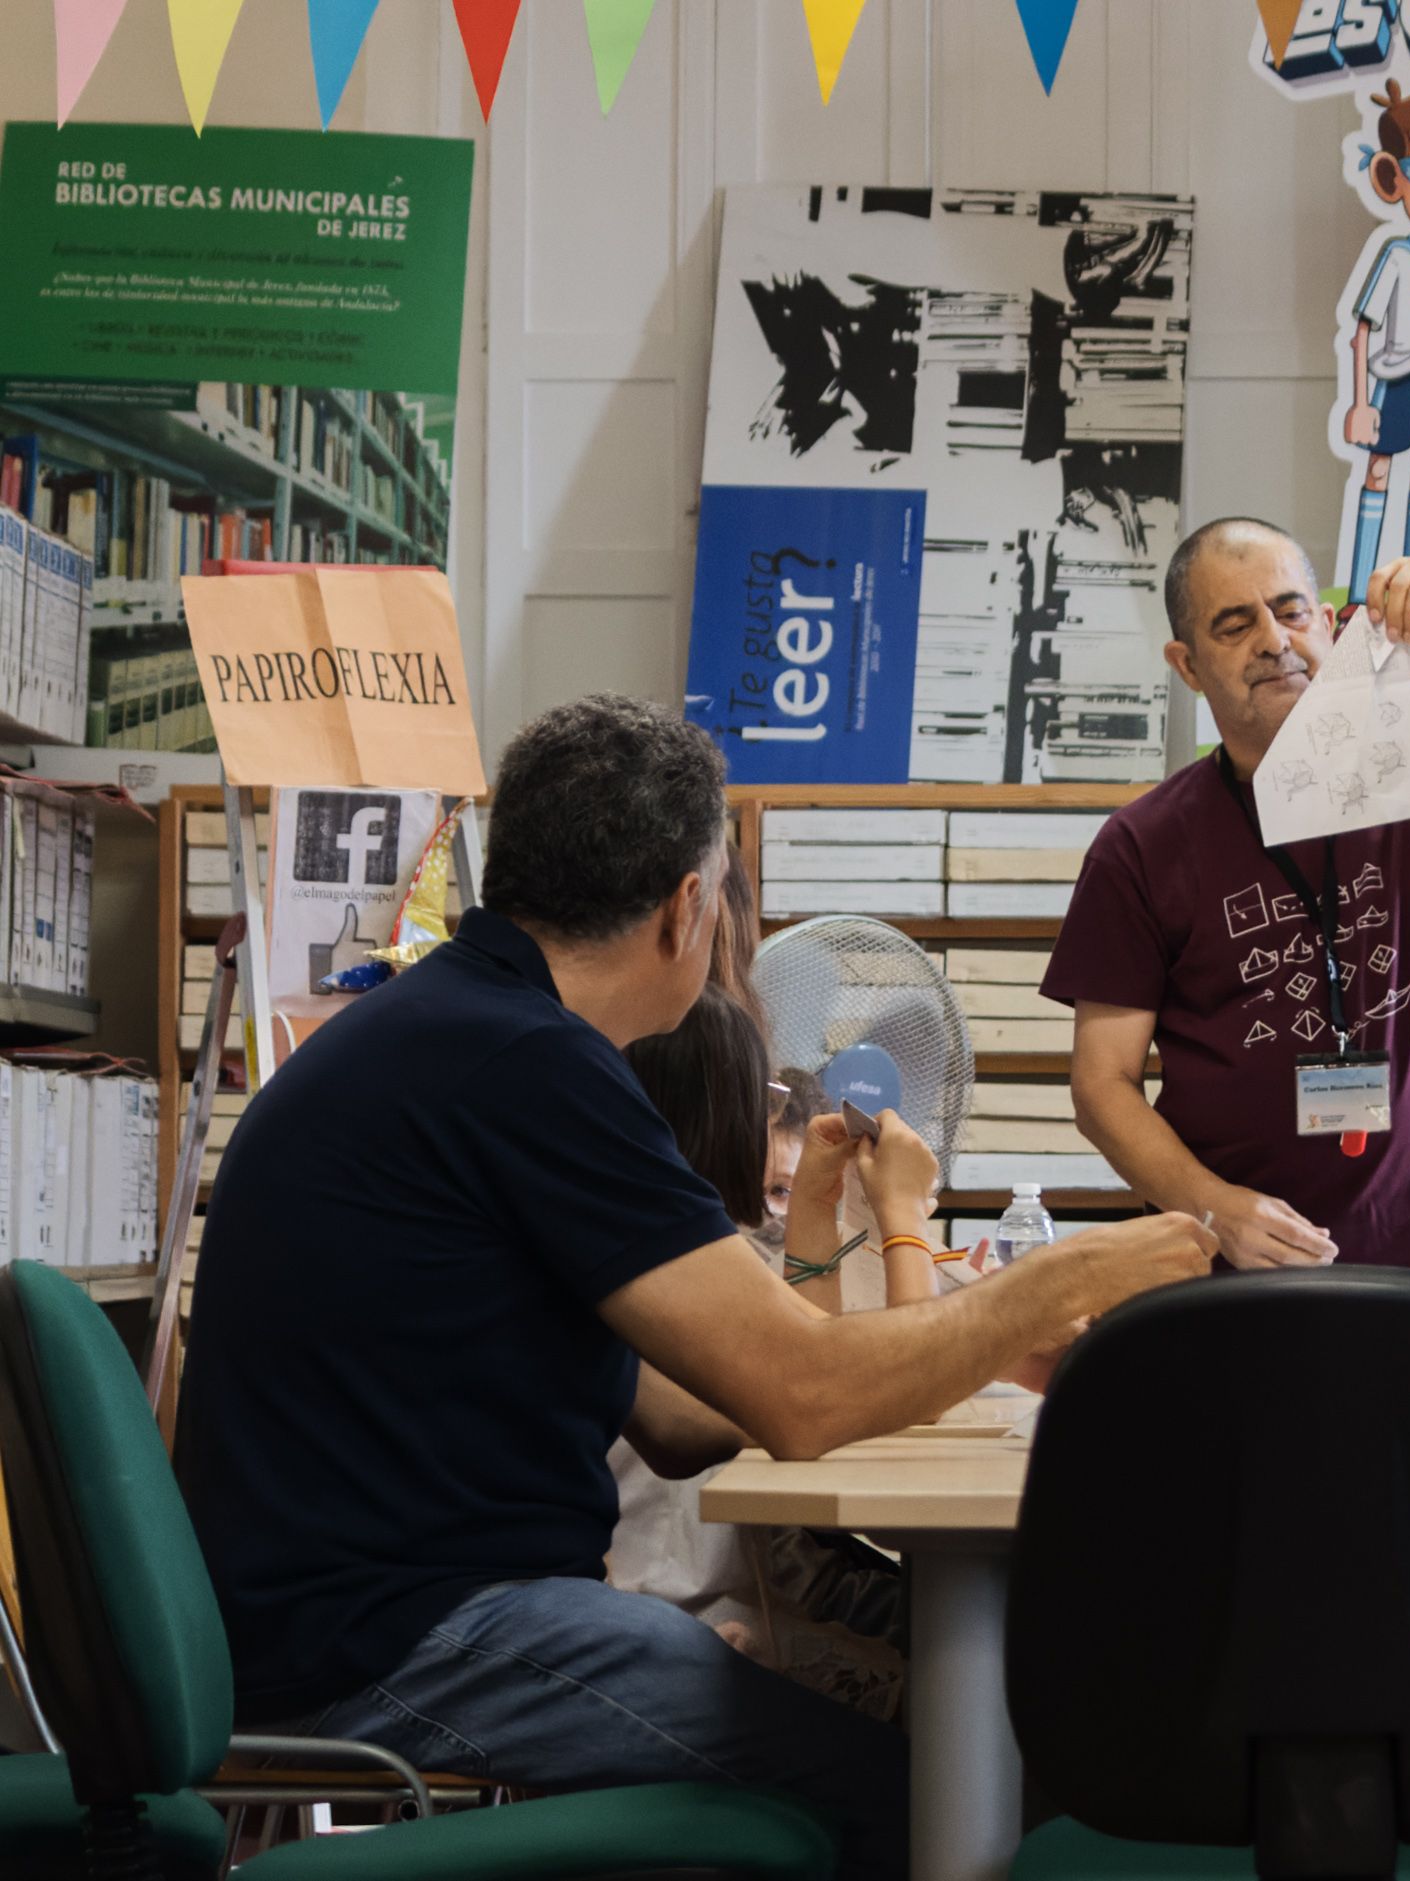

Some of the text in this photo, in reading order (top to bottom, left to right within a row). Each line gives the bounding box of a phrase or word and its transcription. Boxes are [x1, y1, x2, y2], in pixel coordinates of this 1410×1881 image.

[57, 161, 127, 180] RED DE
[55, 182, 410, 219] BIBLIOTECAS MUNICIPALES
[317, 219, 407, 241] DE JEREZ
[743, 551, 783, 662] gusta
[741, 546, 837, 741] leer?
[210, 646, 456, 705] PAPIROFLEXIA
[290, 885, 396, 904] @elmagodelpapel
